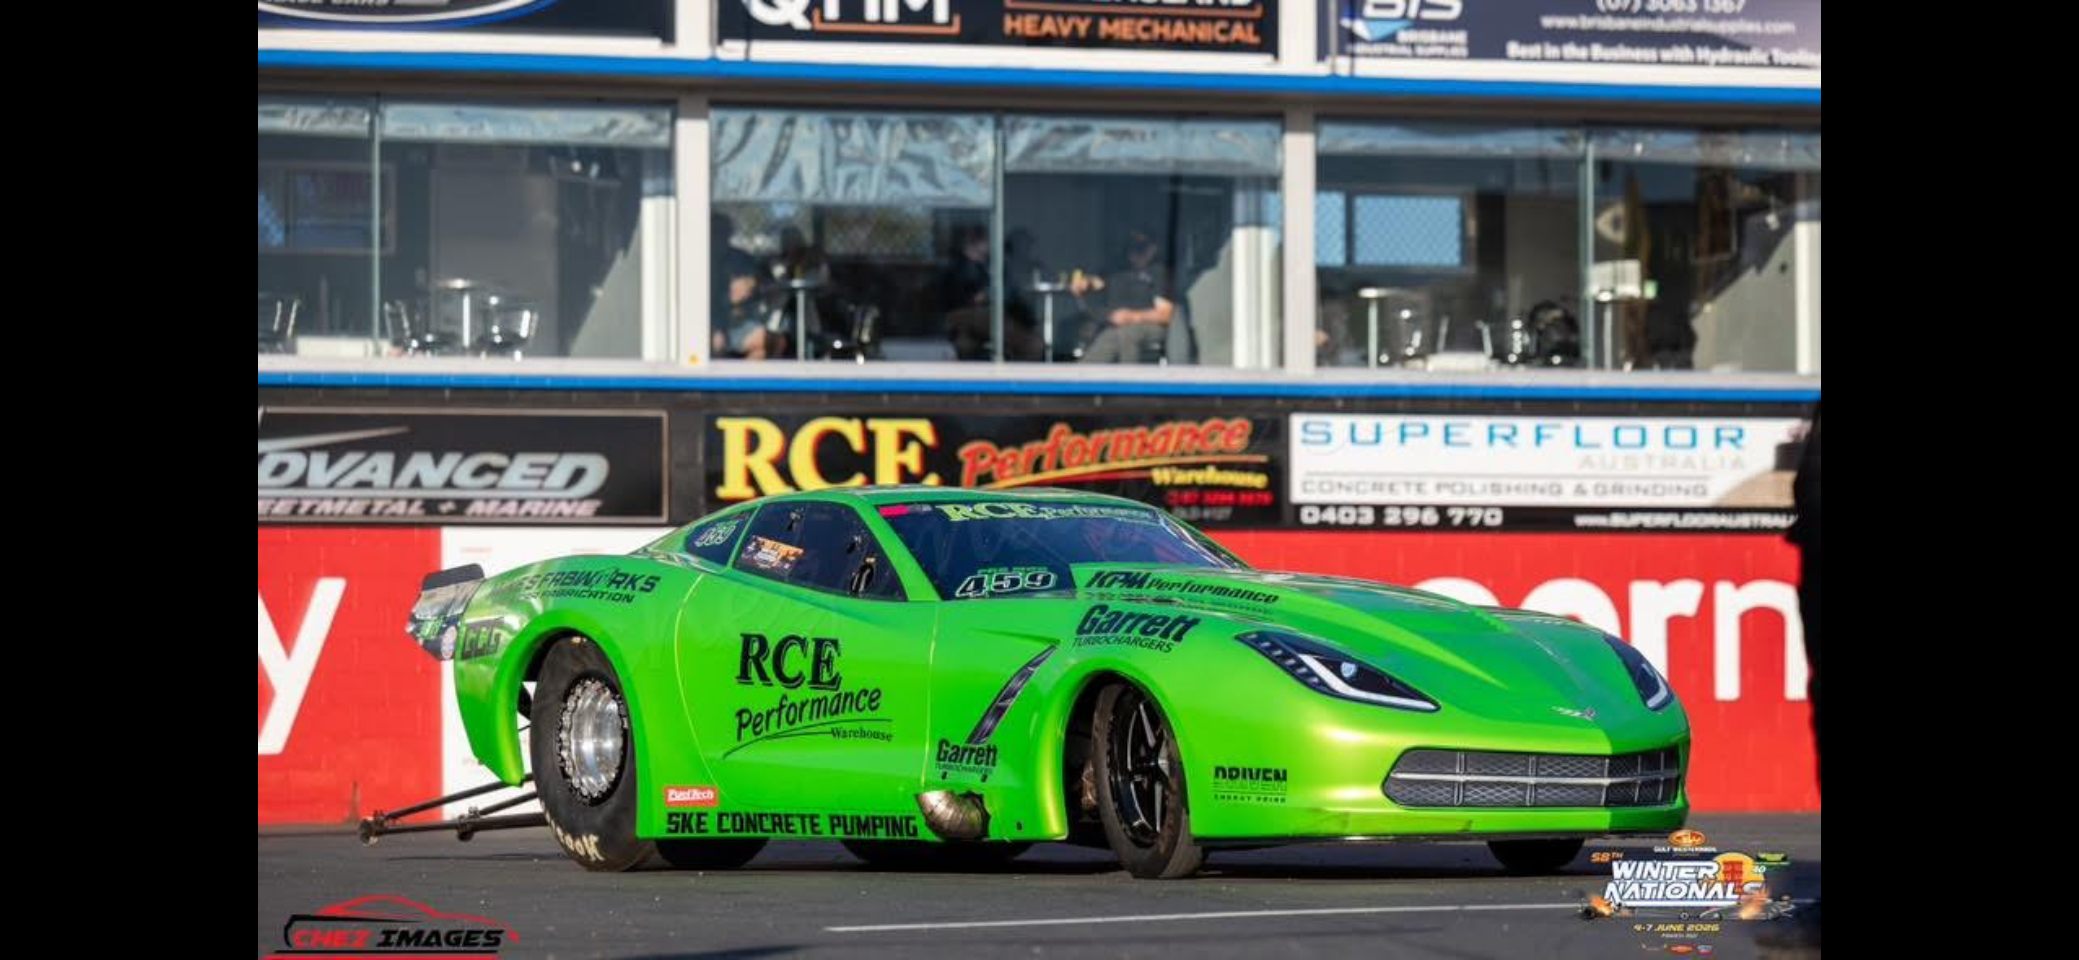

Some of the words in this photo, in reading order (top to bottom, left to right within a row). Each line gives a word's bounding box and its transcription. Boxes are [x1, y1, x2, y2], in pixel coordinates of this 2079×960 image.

[1003, 14, 1091, 38] HEAVY
[1098, 18, 1261, 44] MECHANICAL
[1505, 40, 1541, 59] Best
[1545, 42, 1560, 59] in
[1563, 42, 1589, 60] the
[1590, 43, 1658, 62] Business
[1660, 44, 1694, 63] with
[1696, 45, 1769, 66] Hydraulic
[1300, 420, 1747, 450] SUPERFLOOR
[716, 417, 942, 499] RCE
[957, 419, 1252, 489] Performance
[1578, 455, 1747, 472] AUSTRALIA
[258, 452, 614, 497] DVANCED
[1152, 469, 1268, 490] Warehouse
[1300, 480, 1429, 496] CONCRETE
[1434, 481, 1562, 497] POLISHING
[1573, 482, 1587, 497] &
[1594, 482, 1708, 497] GRINDING
[464, 499, 604, 518] MARINE
[935, 501, 1041, 521] RCE
[1300, 507, 1375, 526] 0403
[1384, 507, 1440, 526] 296
[1447, 507, 1504, 526] 770
[955, 570, 1058, 598] 459
[1085, 570, 1152, 589] KPM
[1148, 577, 1280, 604] Performance
[1076, 603, 1202, 643] Garrett
[1072, 635, 1174, 654] TURBOCHARGERS
[735, 632, 843, 691] RCE
[735, 687, 882, 742] Performance
[830, 727, 893, 742] Warehouse
[936, 738, 998, 767] Garrett
[1214, 766, 1288, 782] DRIVEN
[665, 811, 709, 834] SKE
[716, 811, 823, 836] CONCRETE
[829, 814, 919, 838] PUMPING
